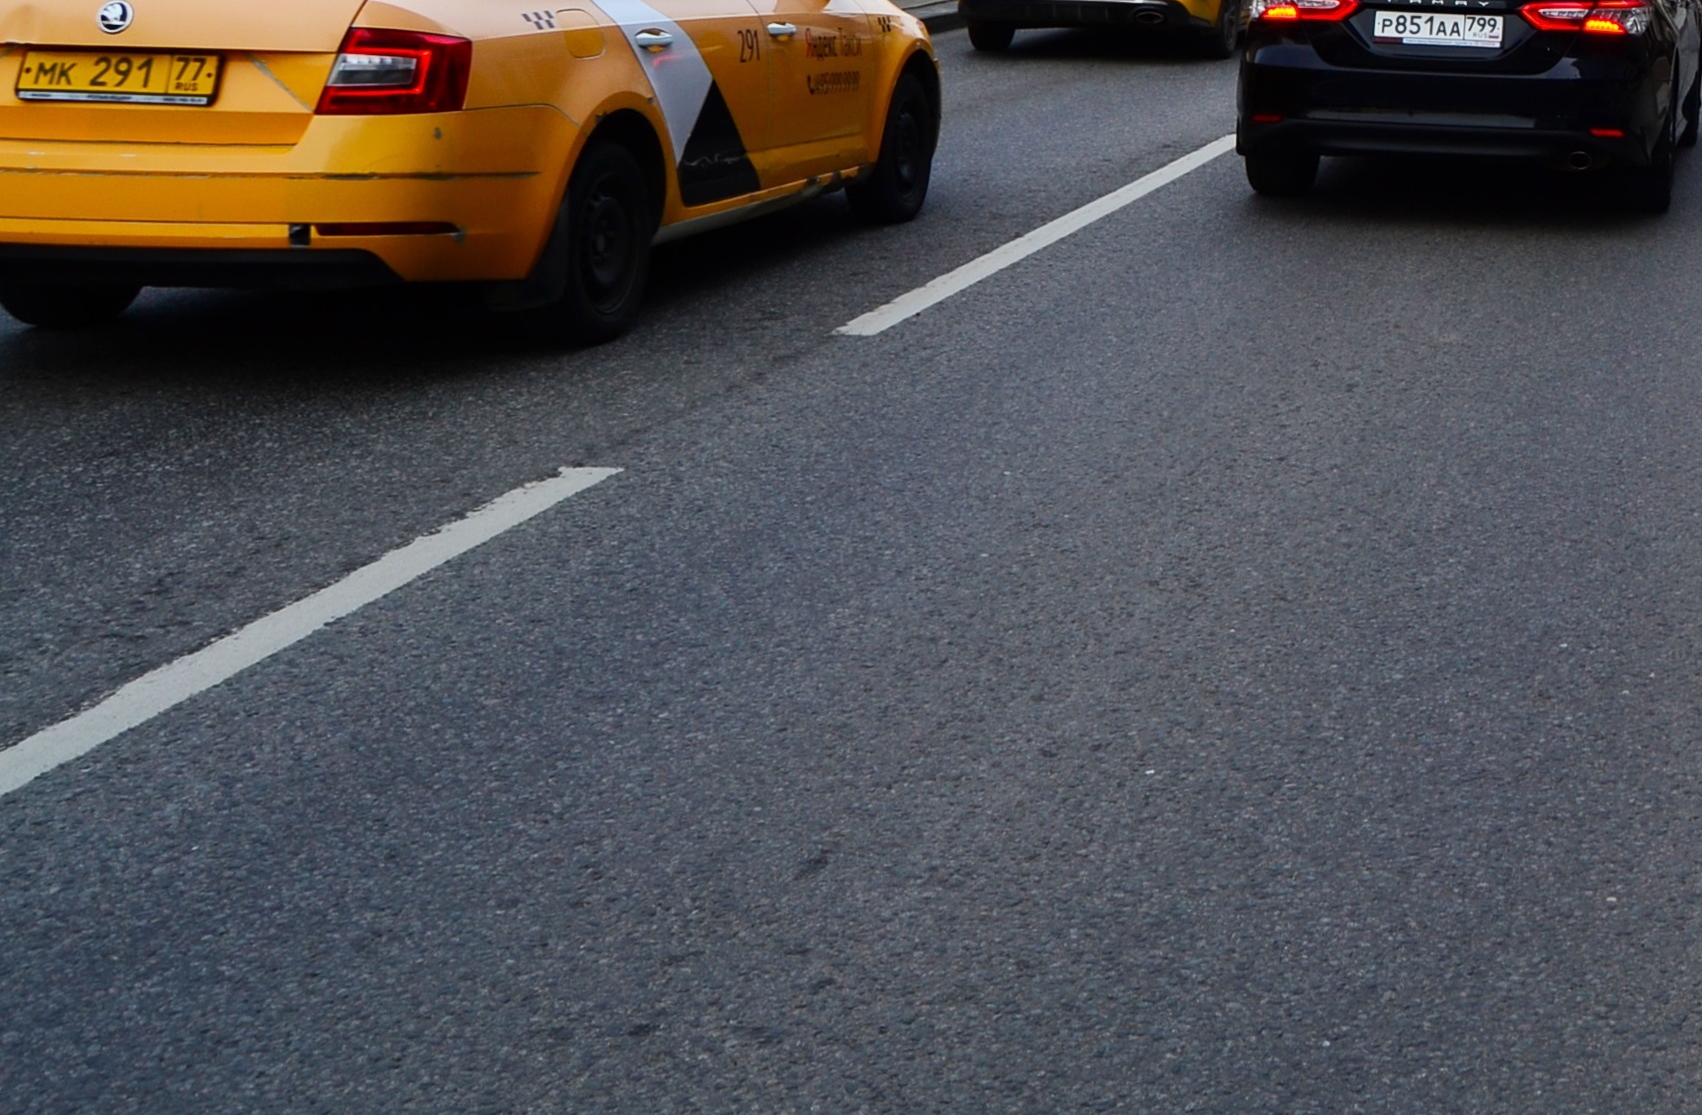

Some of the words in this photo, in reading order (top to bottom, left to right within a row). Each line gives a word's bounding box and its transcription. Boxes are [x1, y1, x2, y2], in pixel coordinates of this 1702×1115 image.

[1466, 16, 1498, 33] 799
[737, 29, 761, 63] 291
[89, 56, 155, 89] 291
[175, 57, 207, 81] 77
[174, 82, 199, 92] RUS
